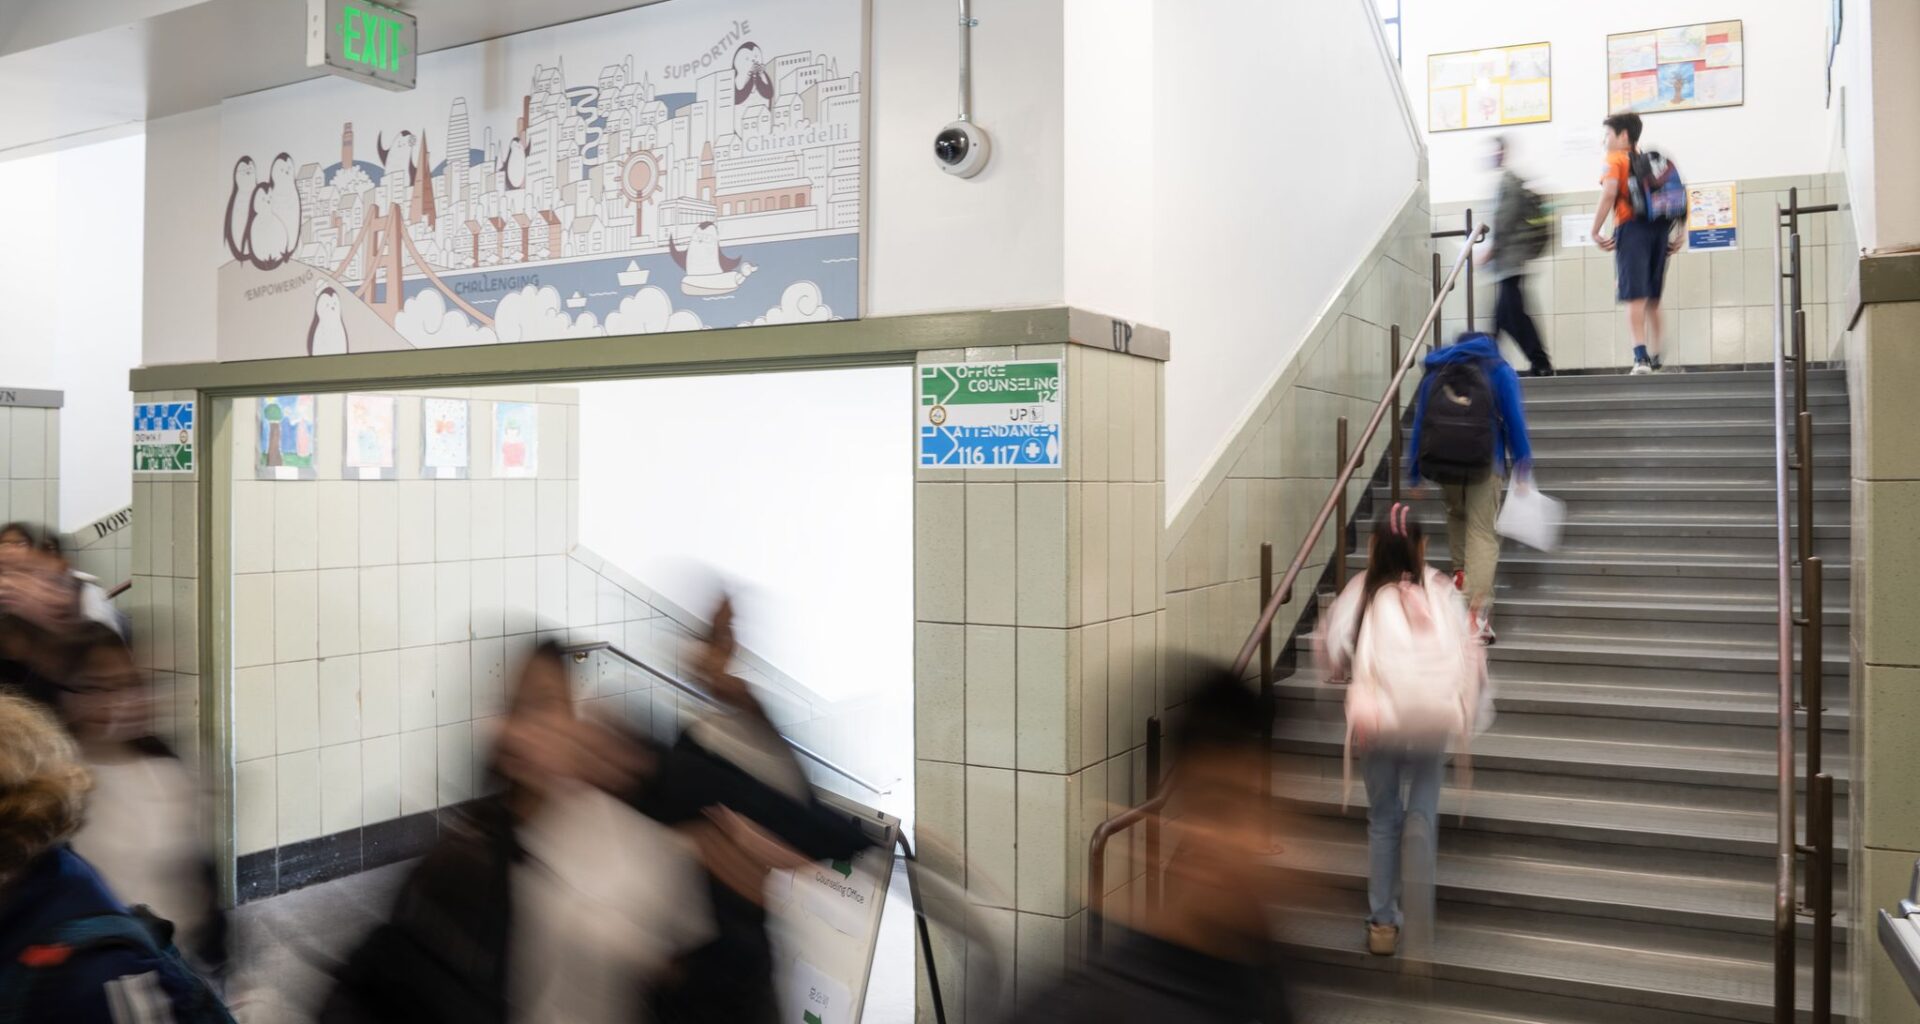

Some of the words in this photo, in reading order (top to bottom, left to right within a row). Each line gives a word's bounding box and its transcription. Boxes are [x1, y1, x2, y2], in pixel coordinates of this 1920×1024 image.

[344, 6, 403, 72] EXIT
[663, 20, 751, 79] SUPPORTIVE
[745, 123, 848, 152] Ghirardelli
[244, 269, 313, 301] EMPOWERING
[454, 274, 540, 294] CHALLENGING
[1112, 320, 1132, 353] UP
[1010, 408, 1028, 421] UP
[952, 424, 1049, 438] ATTENDANCE
[958, 446, 985, 464] 116
[992, 445, 1020, 464] 117
[816, 871, 846, 897] Counseling
[847, 887, 864, 904] Office
